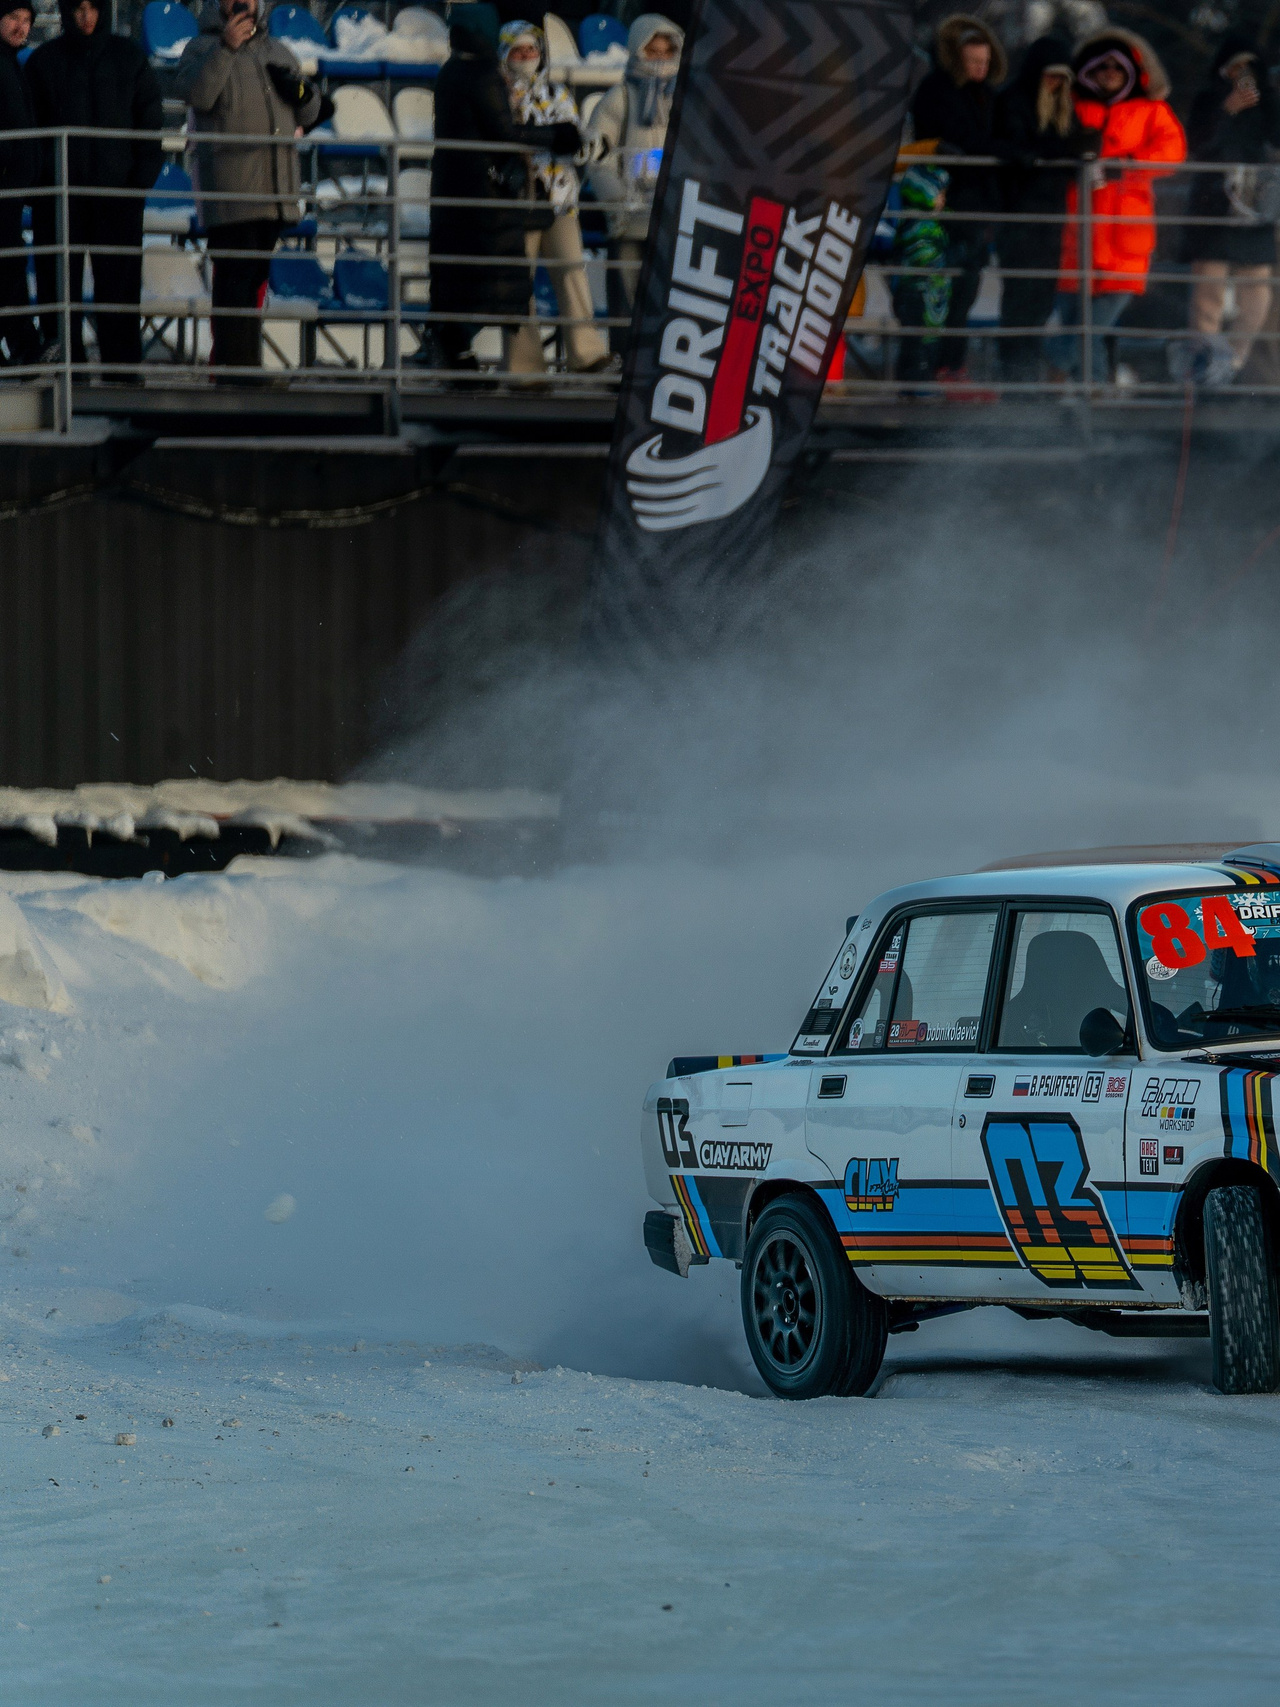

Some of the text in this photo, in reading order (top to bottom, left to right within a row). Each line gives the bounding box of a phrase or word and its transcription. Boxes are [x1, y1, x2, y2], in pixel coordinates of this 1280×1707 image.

[650, 178, 744, 434] DRIFT
[738, 225, 776, 322] EXPO
[1140, 896, 1257, 969] 84
[890, 1024, 900, 1037] 28
[1030, 1075, 1083, 1097] B.PSURTSEV
[1085, 1076, 1100, 1098] 03
[657, 1097, 700, 1169] 03
[1159, 1119, 1195, 1132] WORKSHOP
[982, 1114, 1140, 1287] 03
